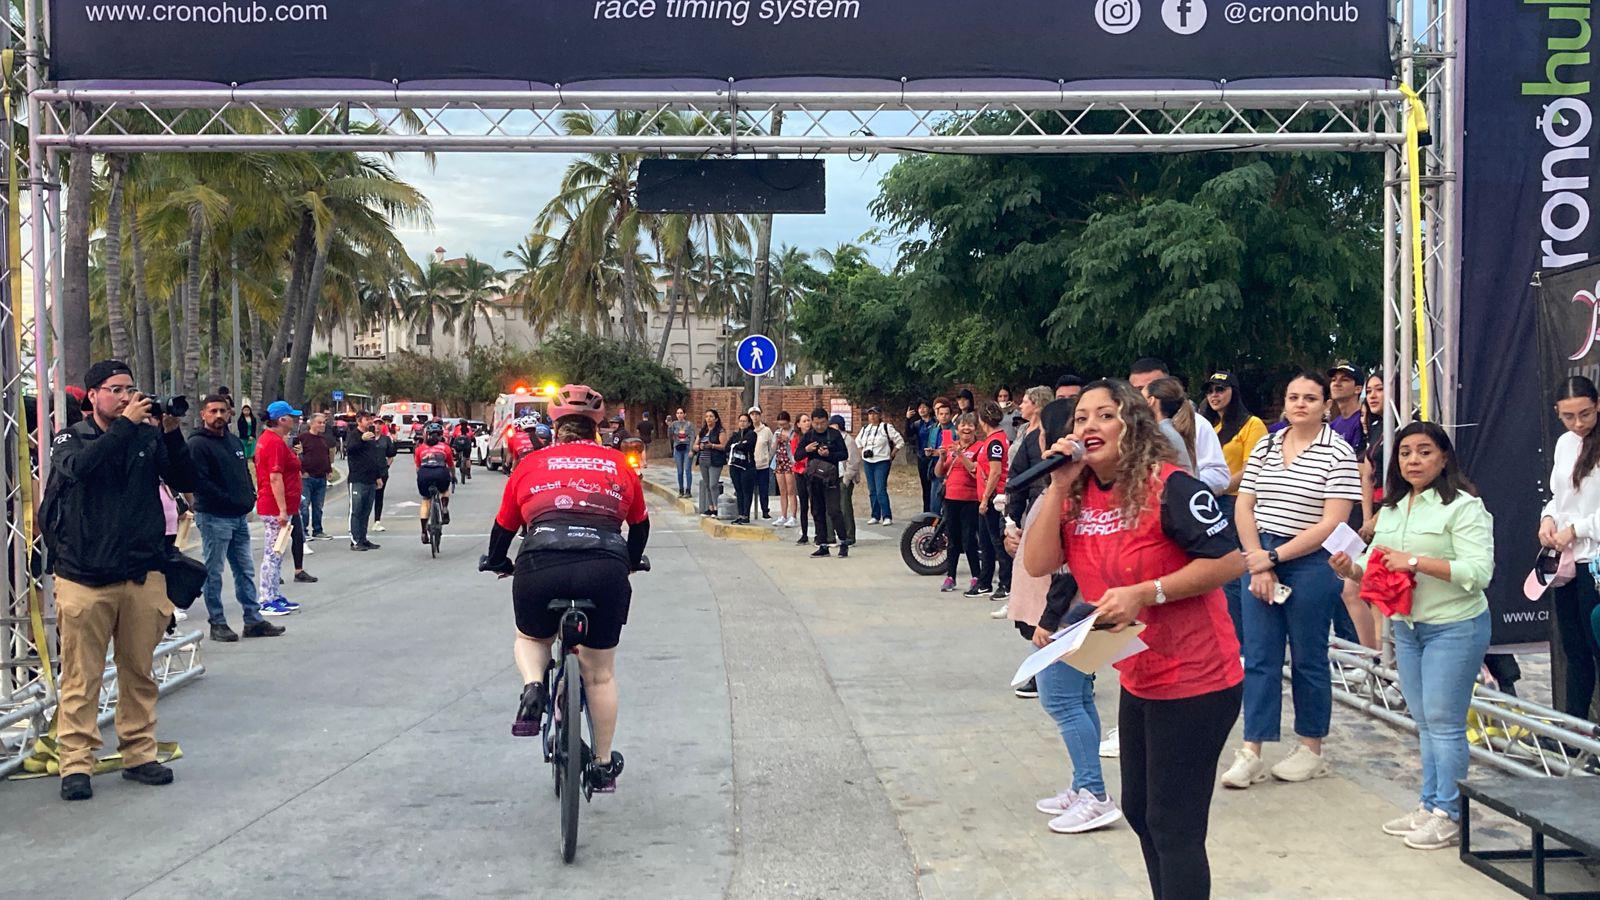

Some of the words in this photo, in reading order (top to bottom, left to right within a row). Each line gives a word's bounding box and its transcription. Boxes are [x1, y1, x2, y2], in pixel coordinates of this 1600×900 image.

[85, 1, 328, 23] www.cronohub.com
[593, 0, 656, 19] race
[666, 0, 750, 26] timing
[758, 0, 860, 25] system
[1224, 1, 1359, 23] @cronohub
[1521, 0, 1593, 268] ronohu
